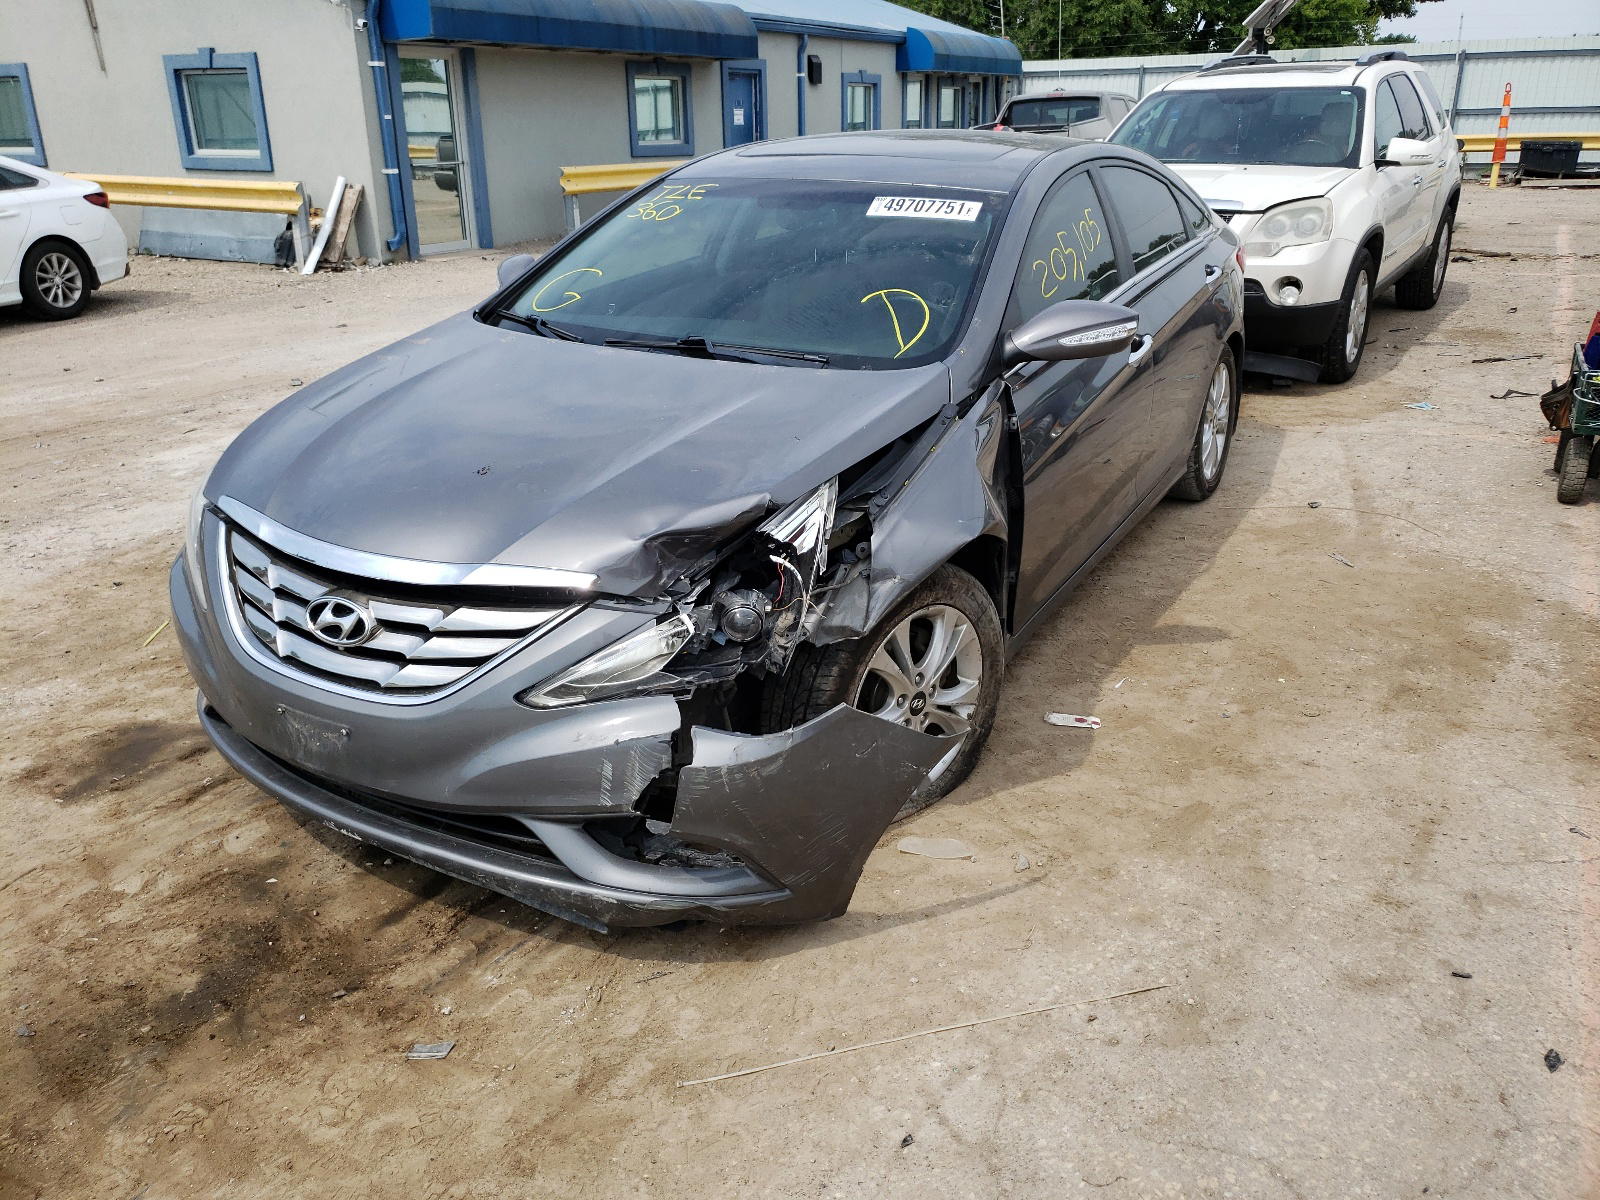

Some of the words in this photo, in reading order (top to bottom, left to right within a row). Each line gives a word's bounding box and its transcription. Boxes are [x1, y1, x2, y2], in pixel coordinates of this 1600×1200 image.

[884, 198, 966, 216] 49707751
[532, 267, 603, 312] G
[860, 288, 930, 360] D
